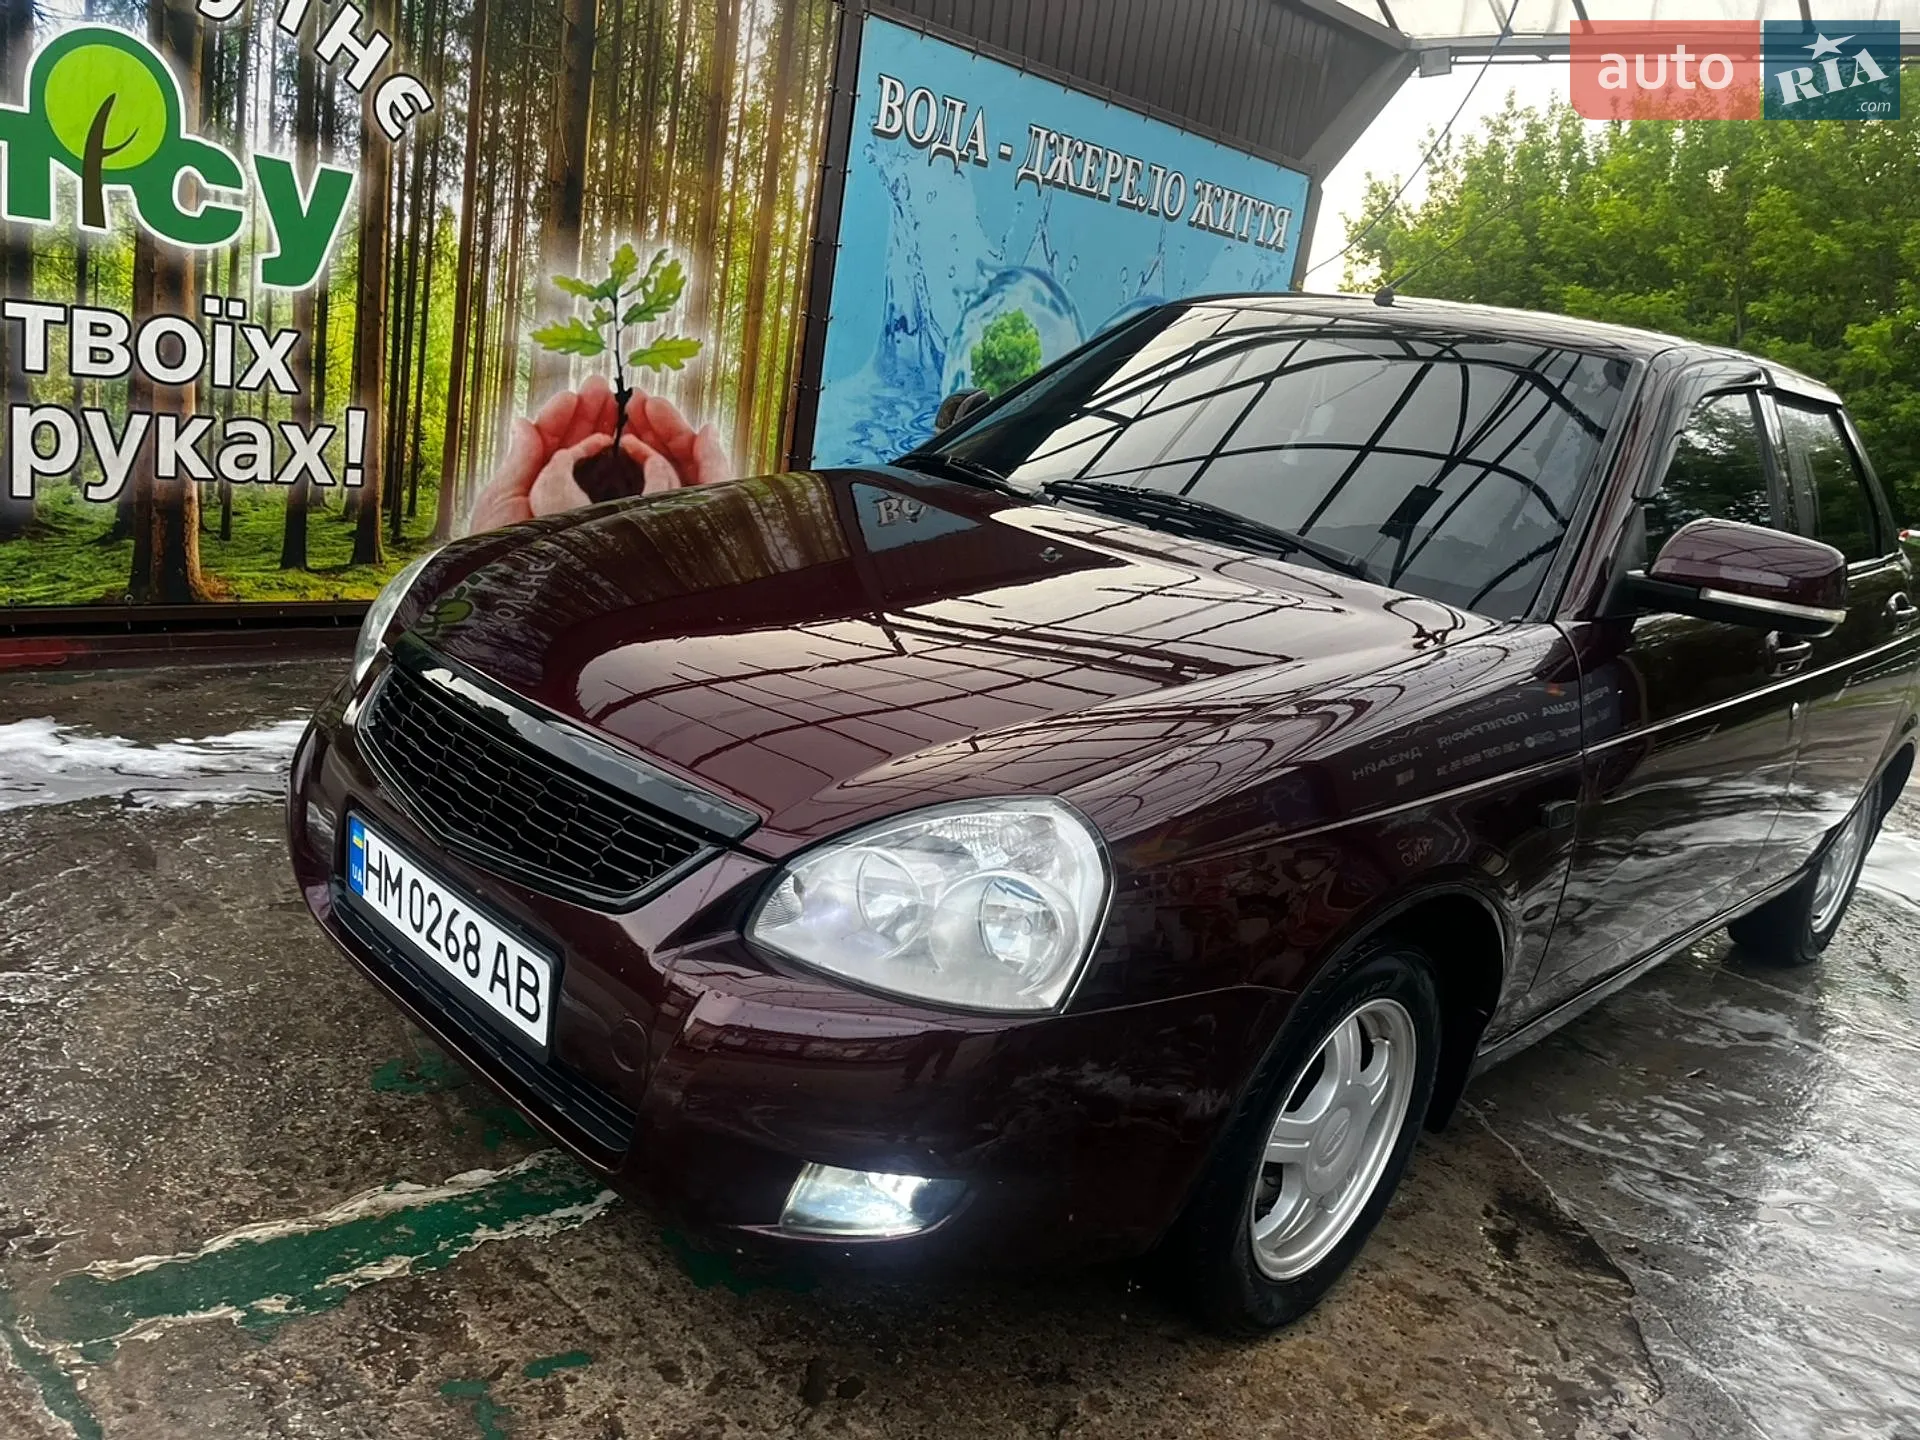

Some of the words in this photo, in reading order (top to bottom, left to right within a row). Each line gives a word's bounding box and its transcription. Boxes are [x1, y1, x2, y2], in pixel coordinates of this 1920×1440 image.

[872, 73, 988, 174] ВОДА
[1015, 124, 1188, 221] ДЖЕРЕЛО
[1189, 178, 1293, 252] ЖИТТЯ
[2, 297, 301, 395] твоїх
[10, 402, 369, 501] руках!
[351, 863, 363, 885] UA
[365, 839, 403, 919] HM
[409, 878, 482, 979] 0268
[488, 940, 541, 1023] AB
